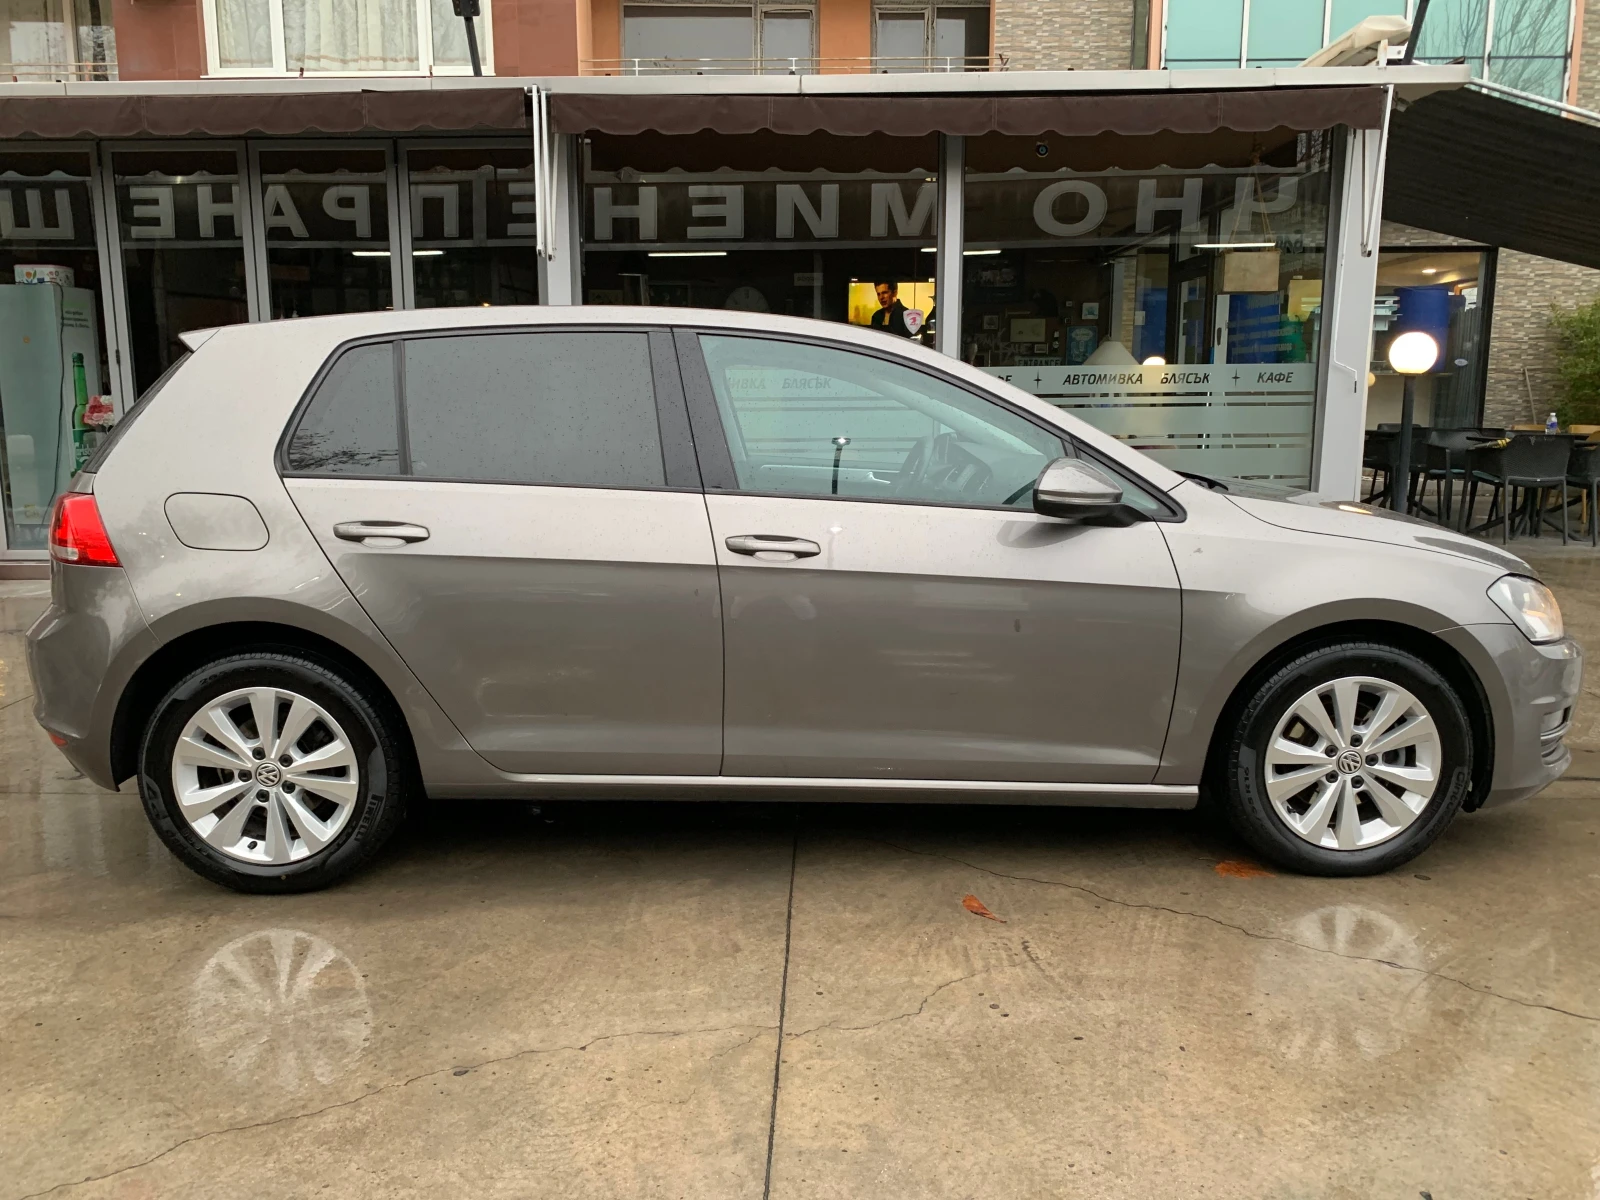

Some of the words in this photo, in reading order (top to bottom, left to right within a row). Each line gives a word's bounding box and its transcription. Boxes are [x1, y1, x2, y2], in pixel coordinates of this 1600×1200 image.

[781, 376, 832, 390] БЛЯСЪК
[1062, 372, 1143, 386] АВТОМИВКА
[1160, 372, 1211, 385] БЛЯСЪК
[1256, 371, 1294, 384] КАФЕ
